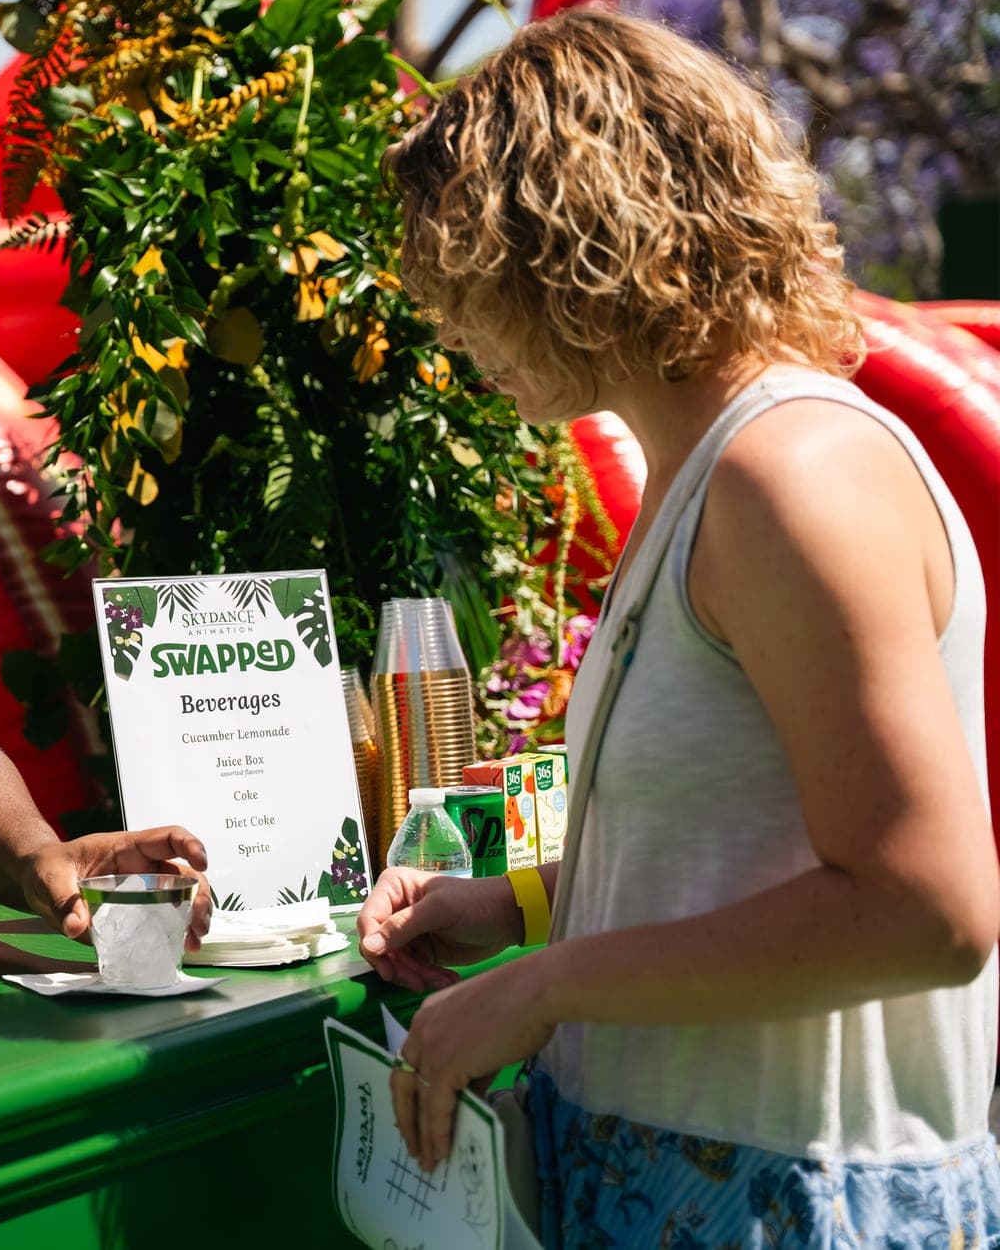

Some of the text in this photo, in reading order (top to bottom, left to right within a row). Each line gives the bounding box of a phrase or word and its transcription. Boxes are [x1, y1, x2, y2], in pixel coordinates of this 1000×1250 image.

[181, 610, 256, 628] SKYDANCE
[188, 626, 254, 637] ANIMATION
[180, 693, 281, 715] Beverages
[181, 726, 290, 744] Cucumber Lemonade
[216, 754, 265, 768] Juice Box
[507, 770, 520, 786] 365
[233, 789, 258, 801] Coke
[225, 814, 275, 829] Diet Coke
[461, 807, 505, 858] Sp
[238, 842, 270, 857] Sprite
